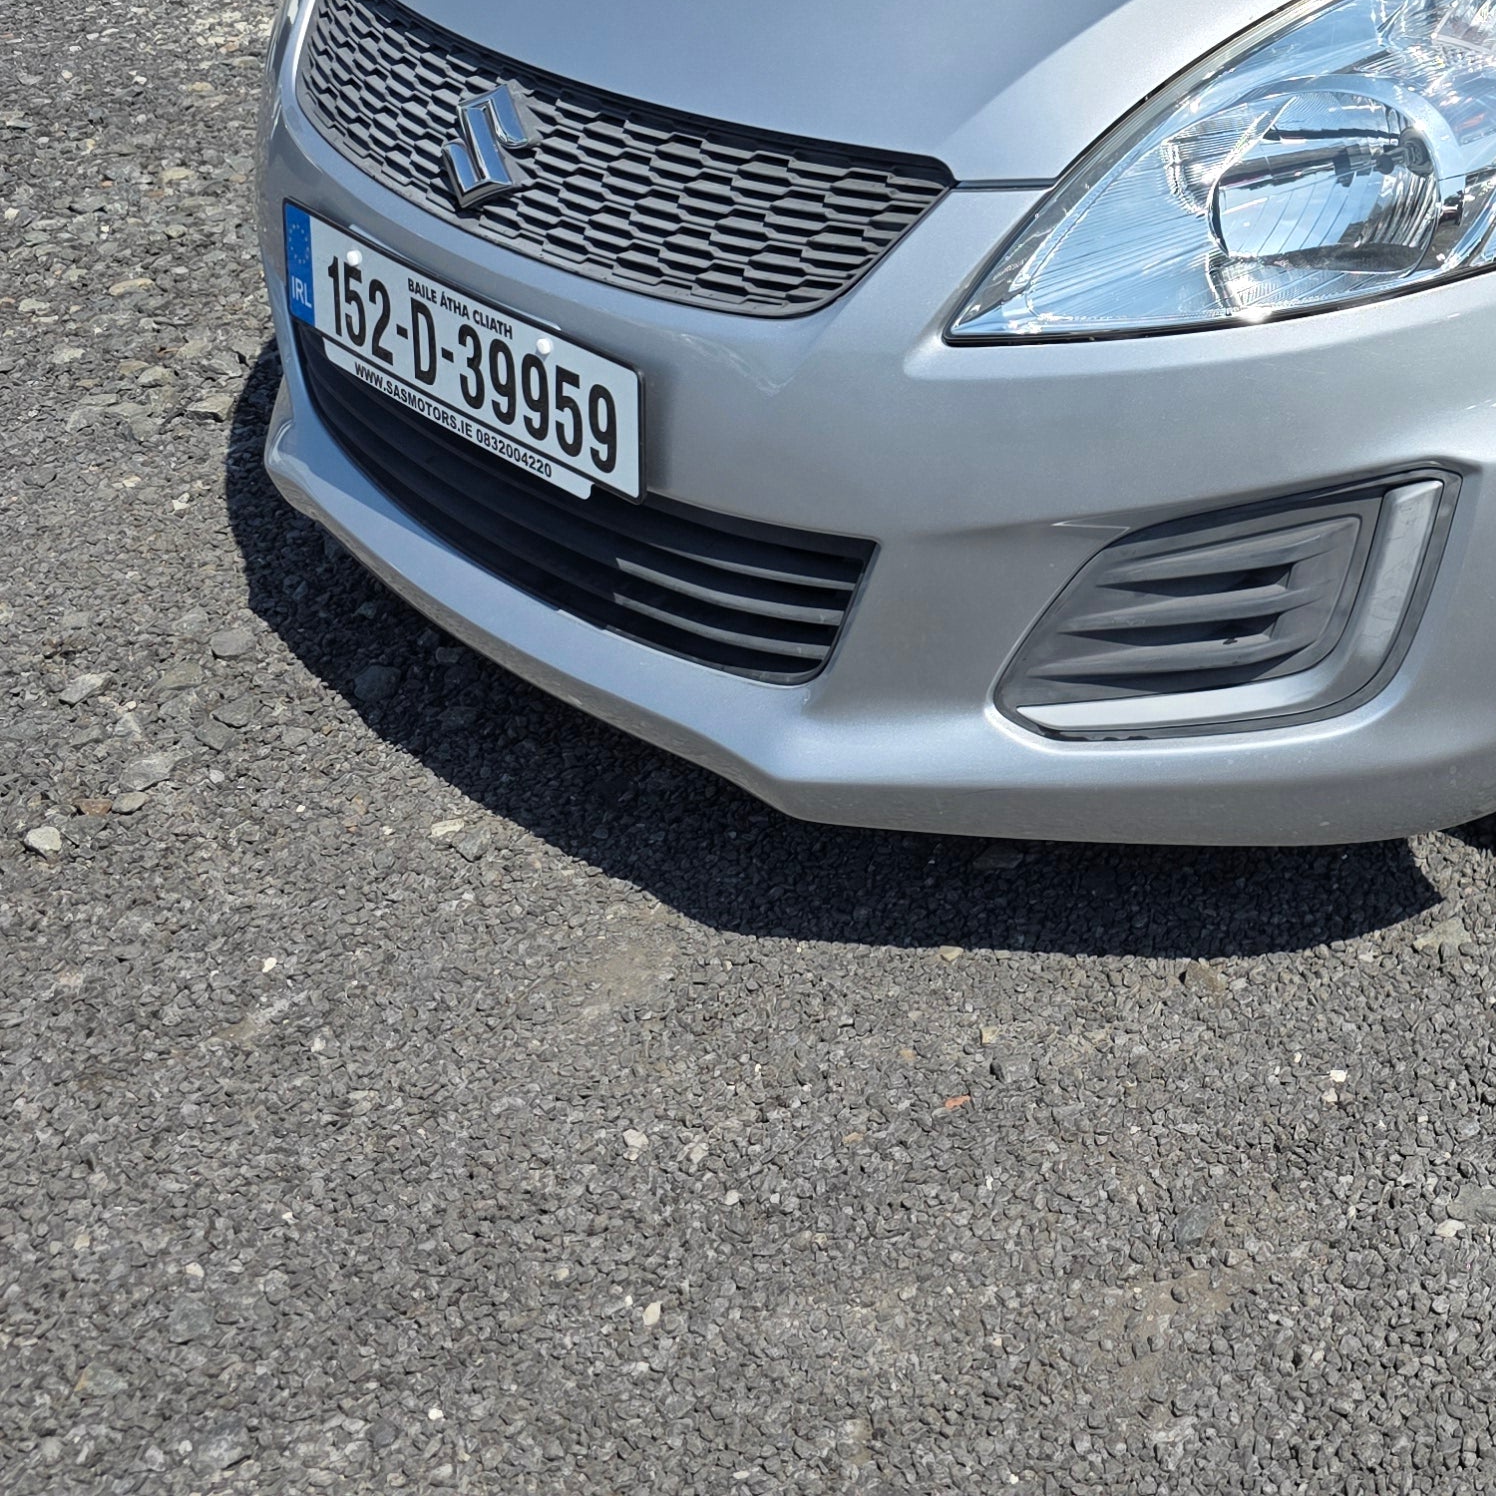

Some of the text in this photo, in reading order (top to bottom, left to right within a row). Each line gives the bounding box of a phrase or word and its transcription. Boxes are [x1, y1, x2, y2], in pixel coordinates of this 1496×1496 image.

[291, 274, 312, 308] IRL
[407, 277, 513, 340] BAILE ÁTHA CLIATH
[327, 255, 617, 474] 152-D-39959
[354, 361, 552, 478] WWW.SASMOTORS.IE 0832004220
